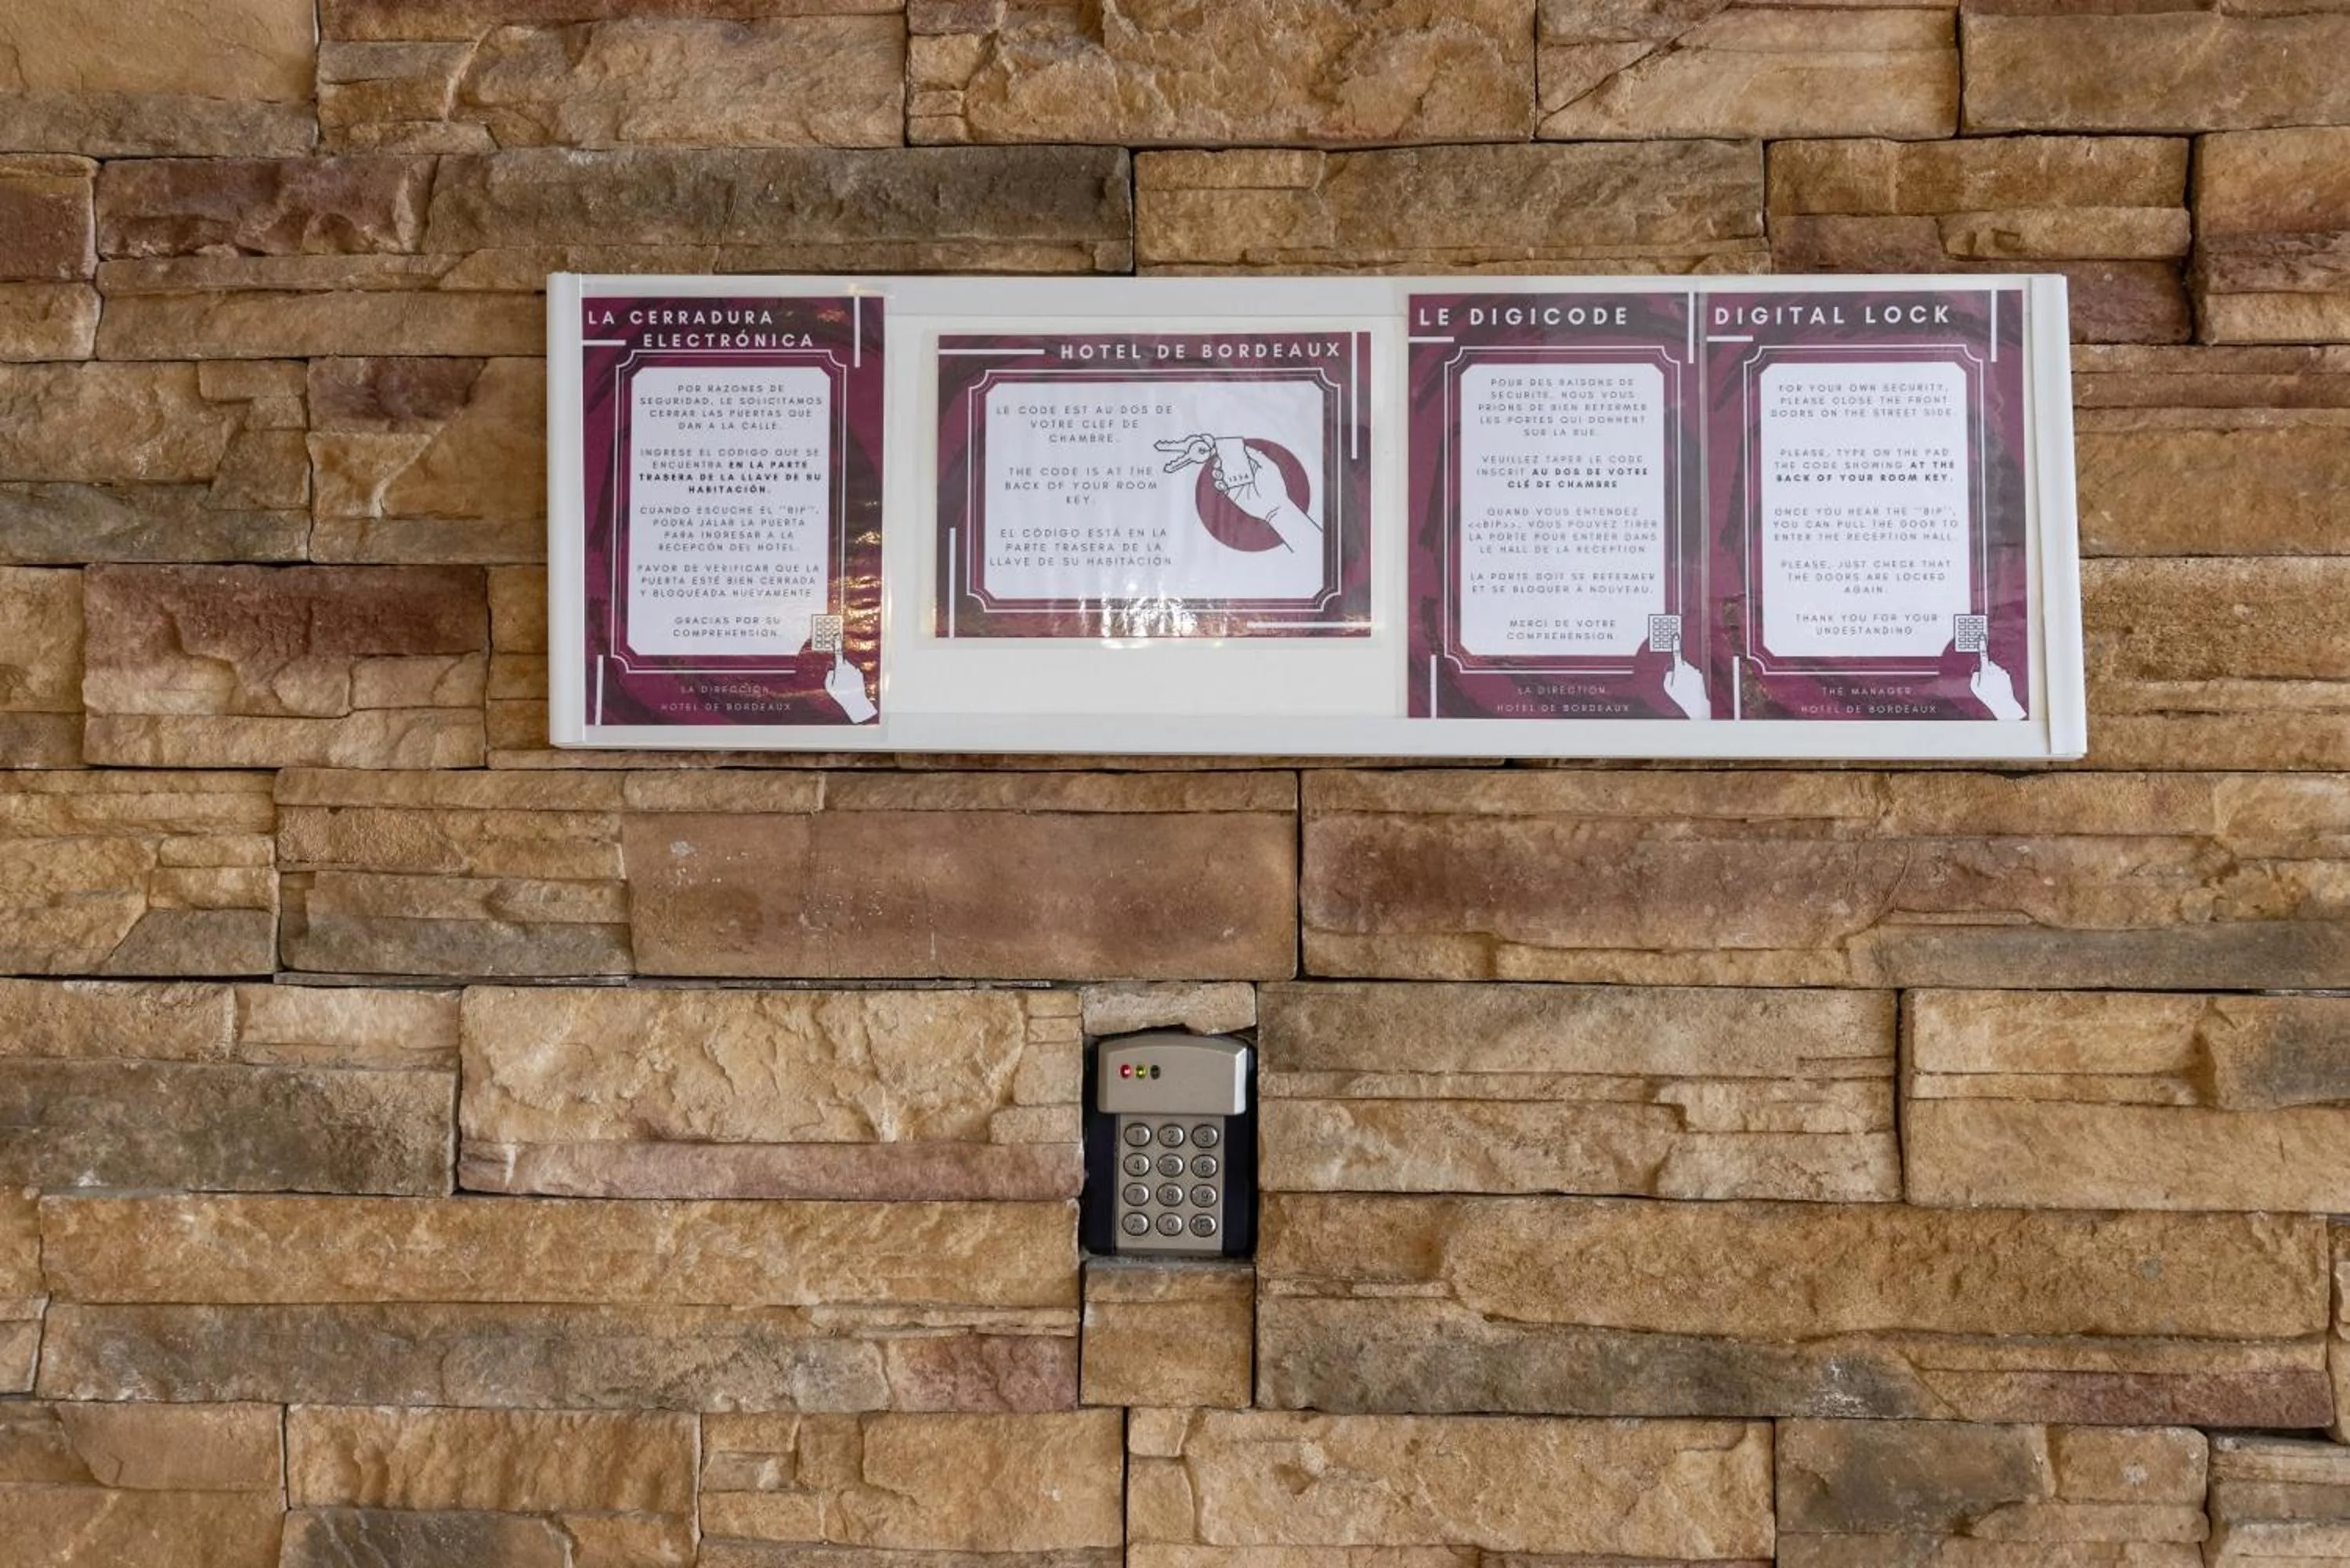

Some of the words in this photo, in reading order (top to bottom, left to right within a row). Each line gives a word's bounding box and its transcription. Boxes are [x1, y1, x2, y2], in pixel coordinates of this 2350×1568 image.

[588, 310, 614, 325] LA
[629, 310, 773, 325] CERRADURA
[1419, 308, 1448, 327] LE
[1470, 306, 1627, 326] DIGICODE
[1715, 306, 1845, 325] DIGITAL
[1865, 305, 1949, 324] LOCK
[643, 330, 814, 348] ELECTRÓNICA
[1061, 343, 1141, 359] HOTEL
[1157, 344, 1184, 359] DE
[1202, 341, 1340, 359] BORDEAUX
[678, 385, 701, 393] POR
[707, 385, 763, 393] RAZONES
[769, 384, 783, 393] DE
[1778, 383, 1802, 393] FOR
[1809, 384, 1842, 393] YOUR
[1849, 383, 1876, 392] OWN
[1780, 396, 1825, 406] PLEASE
[1831, 396, 1871, 406] CLOSE
[1879, 396, 1900, 405] THE
[1907, 396, 1947, 404] FRONT
[649, 409, 695, 418] CERRAR
[702, 410, 723, 418] LAS
[728, 409, 782, 417] PUERTAS
[788, 409, 812, 418] QUE
[996, 405, 1009, 415] LE
[1018, 405, 1055, 415] CODE
[1065, 405, 1087, 415] EST
[1095, 405, 1112, 414] AU
[1120, 405, 1148, 414] DOS
[1155, 405, 1173, 414] DE
[1770, 408, 1813, 418] DOORS
[1820, 408, 1837, 418] ON
[1844, 408, 1865, 417] THE
[1873, 408, 1916, 417] STREET
[1030, 419, 1073, 429] VOTRE
[1082, 419, 1113, 429] CLEF
[1123, 419, 1138, 429] DE
[728, 461, 743, 469] EN
[749, 461, 764, 469] LA
[770, 461, 808, 469] PARTE
[1802, 461, 1836, 470] CODE
[1911, 461, 1925, 469] AT
[1932, 461, 1954, 469] THE
[1009, 467, 1032, 476] THE
[1039, 467, 1078, 476] CODE
[1086, 467, 1099, 476] IS
[1106, 467, 1121, 476] AT
[1130, 467, 1152, 476] THE
[1531, 468, 1548, 476] AU
[1555, 468, 1580, 476] DOS
[1586, 468, 1600, 476] DE
[1608, 467, 1647, 476] VOTRE
[639, 473, 693, 482] TRASERA
[700, 473, 713, 482] DE
[720, 473, 734, 482] LA
[741, 473, 778, 482] LLAVE
[785, 473, 798, 482] DE
[806, 473, 822, 482] SU
[1776, 474, 1810, 482] BACK
[1817, 474, 1832, 482] OF
[1839, 473, 1873, 482] YOUR
[1879, 473, 1917, 482] ROOM
[1005, 481, 1039, 490] BACK
[1047, 481, 1063, 490] OF
[1072, 481, 1108, 490] YOUR
[1116, 481, 1157, 490] ROOM
[1507, 479, 1529, 489] CLÉ
[1536, 480, 1550, 489] DE
[1557, 479, 1618, 489] CHAMBRE
[639, 506, 690, 515] CUANDO
[696, 506, 752, 515] ESCUCHE
[759, 506, 772, 515] EL
[653, 518, 693, 527] PODRÁ
[700, 518, 734, 527] JALAR
[740, 518, 754, 527] LA
[761, 518, 805, 527] PUERTA
[1773, 519, 1798, 529] YOU
[1806, 520, 1830, 529] CAN
[1837, 519, 1865, 529] PULL
[1872, 519, 1893, 529] THE
[1900, 519, 1935, 529] DOOR
[1943, 519, 1959, 529] TO
[663, 530, 694, 540] PARA
[701, 530, 761, 540] INGRESAR
[781, 530, 794, 540] LA
[1000, 529, 1014, 538] EL
[1128, 527, 1144, 538] EN
[1152, 528, 1166, 538] LA
[1005, 542, 1046, 552] PARTE
[1054, 542, 1114, 552] TRASERA
[1123, 542, 1137, 552] DE
[1146, 542, 1162, 552] LA
[989, 556, 1030, 566] LLAVE
[1038, 557, 1054, 566] DE
[1062, 557, 1079, 566] SU
[641, 576, 685, 585] PUERTA
[691, 575, 720, 585] ESTÉ
[726, 576, 753, 585] BIEN
[760, 576, 815, 585] CERRADA
[1788, 573, 1808, 582] THE
[1815, 573, 1859, 582] DOORS
[1866, 573, 1888, 581] ARE
[1896, 573, 1946, 582] LOCKED
[674, 616, 729, 625] GRACIAS
[736, 616, 759, 625] POR
[766, 616, 781, 625] SU
[1795, 613, 1833, 623] THANK
[1842, 613, 1867, 623] YOU
[1873, 613, 1896, 622] FOR
[1904, 613, 1937, 623] YOUR
